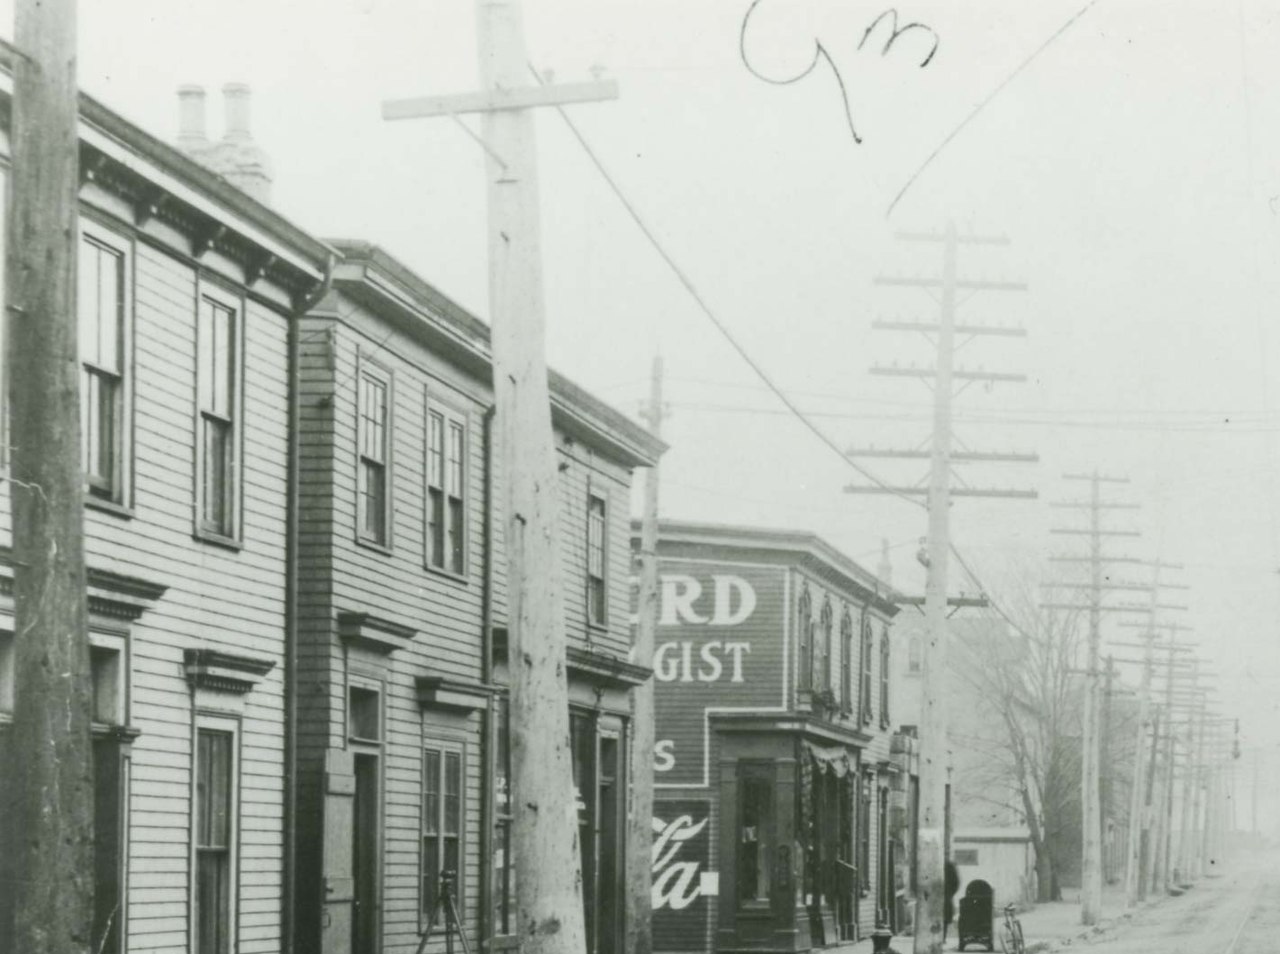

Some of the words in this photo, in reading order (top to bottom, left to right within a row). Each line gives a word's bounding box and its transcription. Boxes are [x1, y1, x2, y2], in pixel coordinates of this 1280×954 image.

[629, 574, 757, 626] RD
[629, 640, 752, 683] GIST
[651, 739, 676, 772] S
